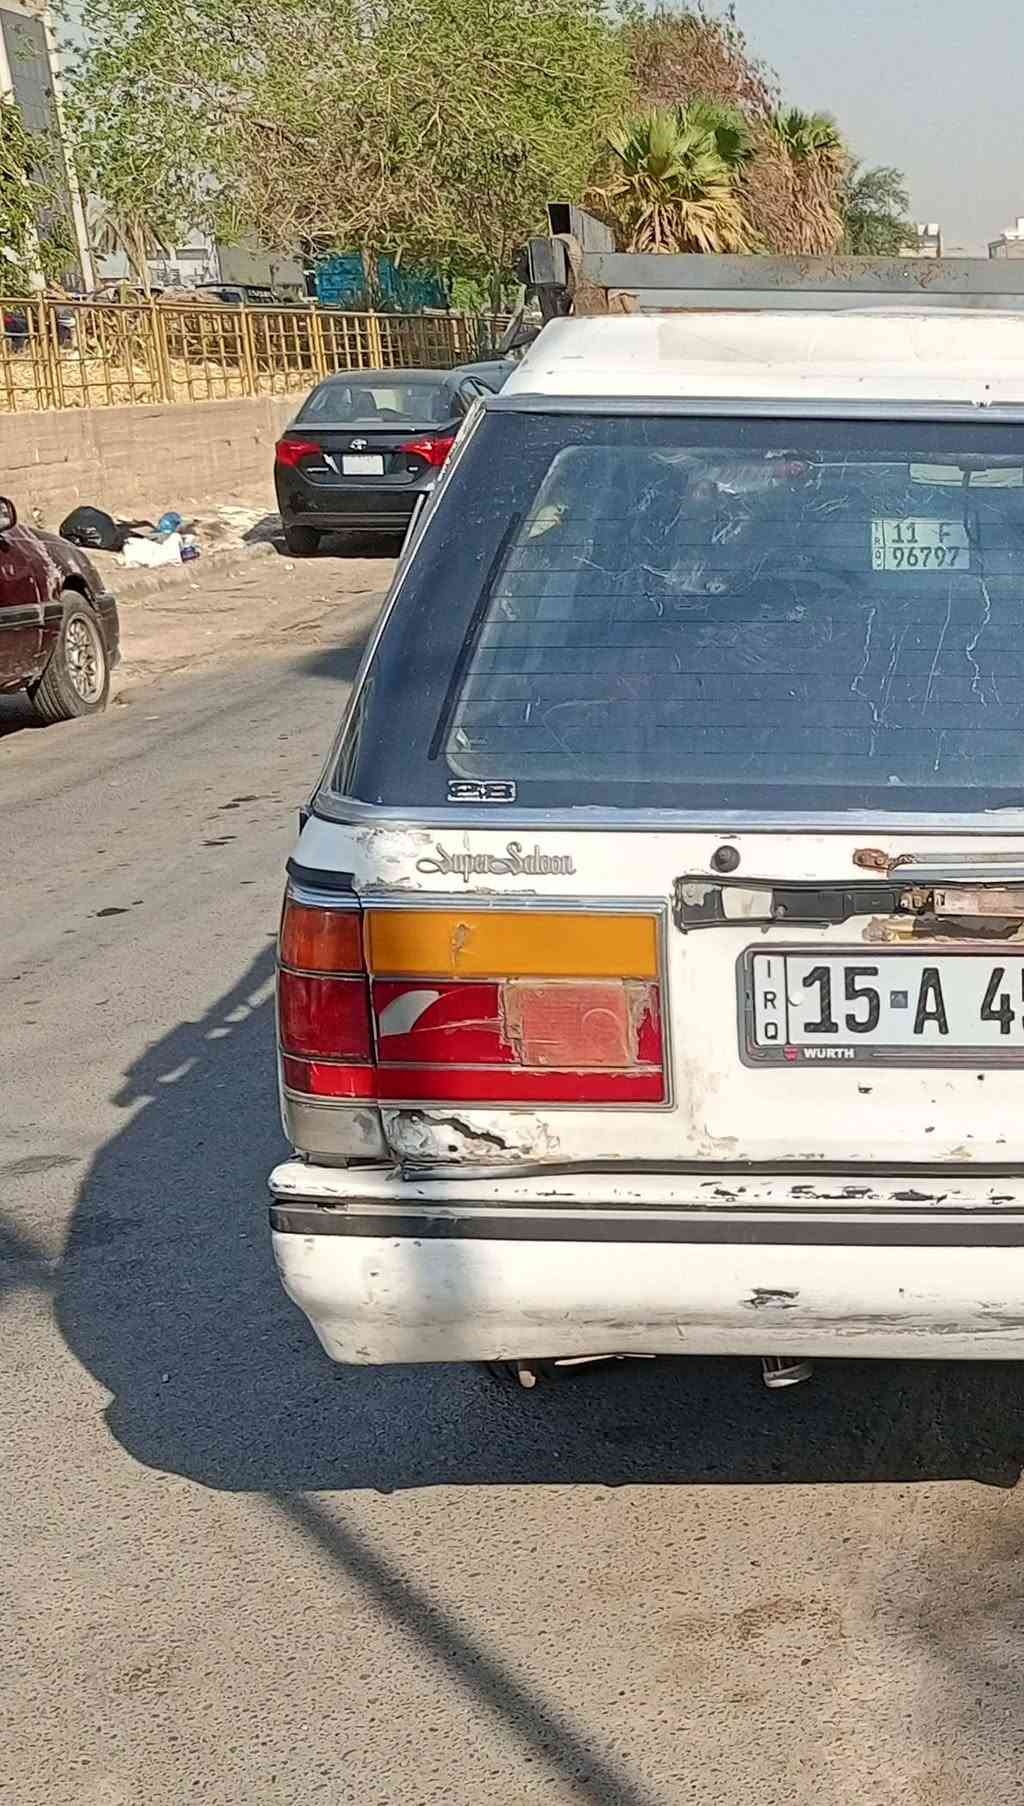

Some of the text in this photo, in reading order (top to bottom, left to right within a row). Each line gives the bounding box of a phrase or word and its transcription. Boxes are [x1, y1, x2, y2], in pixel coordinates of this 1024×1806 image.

[891, 523, 918, 543] 11
[893, 547, 959, 567] 96797
[416, 841, 576, 883] Super Saloon
[802, 966, 881, 1034] 15
[913, 967, 949, 1035] A
[803, 1047, 855, 1059] WURTH
